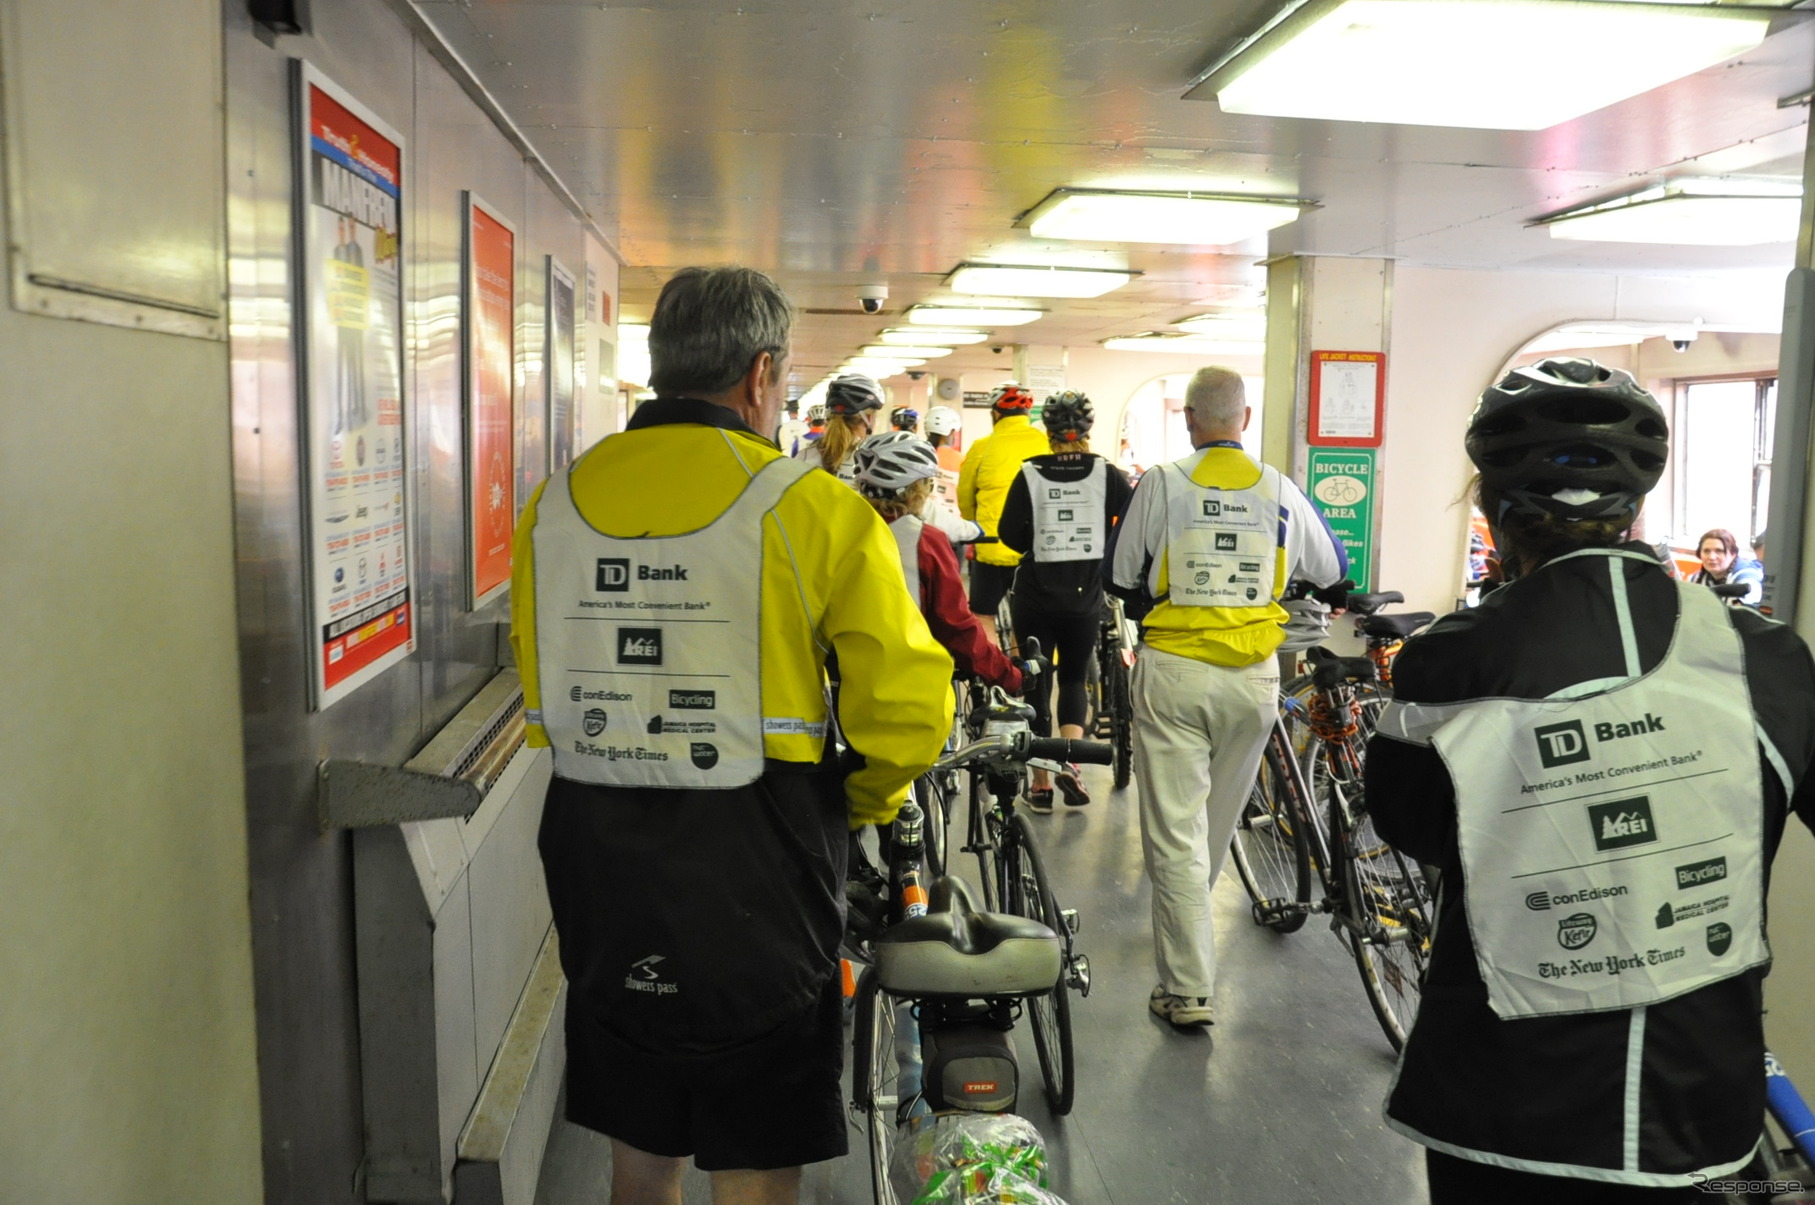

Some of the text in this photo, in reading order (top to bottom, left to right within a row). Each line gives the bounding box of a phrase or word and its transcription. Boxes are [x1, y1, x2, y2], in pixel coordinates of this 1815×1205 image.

[1315, 463, 1368, 475] BICYCLE
[1223, 504, 1248, 513] Bank
[1323, 508, 1357, 519] AREA
[637, 564, 688, 581] Bank
[578, 600, 613, 609] America's
[614, 601, 636, 609] Most
[637, 601, 683, 610] Convenient
[582, 691, 633, 702] conEdison
[671, 693, 713, 707] Bicycling
[1595, 713, 1665, 742] Bank
[574, 740, 668, 761] The New York Times
[1520, 775, 1573, 795] America's
[1575, 769, 1605, 785] Most
[1607, 759, 1670, 779] Convenient
[1678, 862, 1725, 884] Bicycling
[1552, 885, 1628, 905] conEdison
[1676, 910, 1705, 921] MEDICAL
[1564, 929, 1591, 946] Kefir
[1538, 946, 1685, 979] The New York Times
[656, 982, 678, 995] pass
